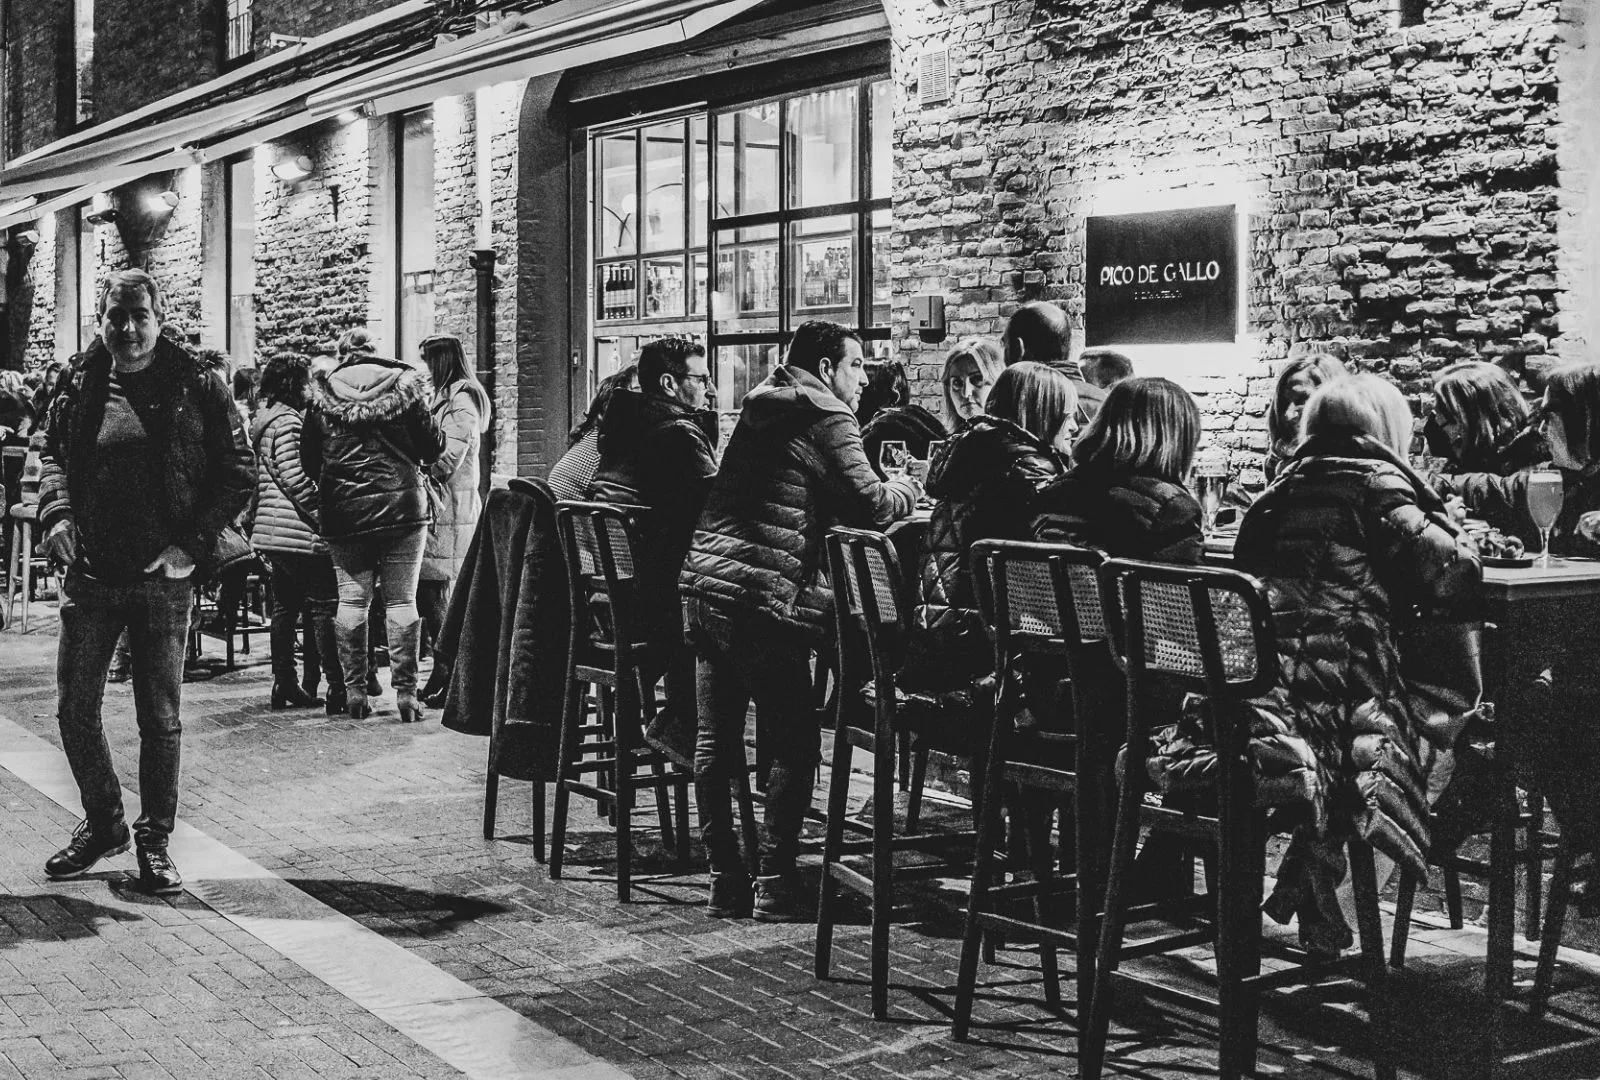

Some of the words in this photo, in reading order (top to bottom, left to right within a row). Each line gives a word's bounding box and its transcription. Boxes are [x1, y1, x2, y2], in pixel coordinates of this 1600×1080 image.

[1100, 265, 1134, 286] PICO
[1138, 264, 1159, 284] DE
[1163, 260, 1220, 282] GALLO
